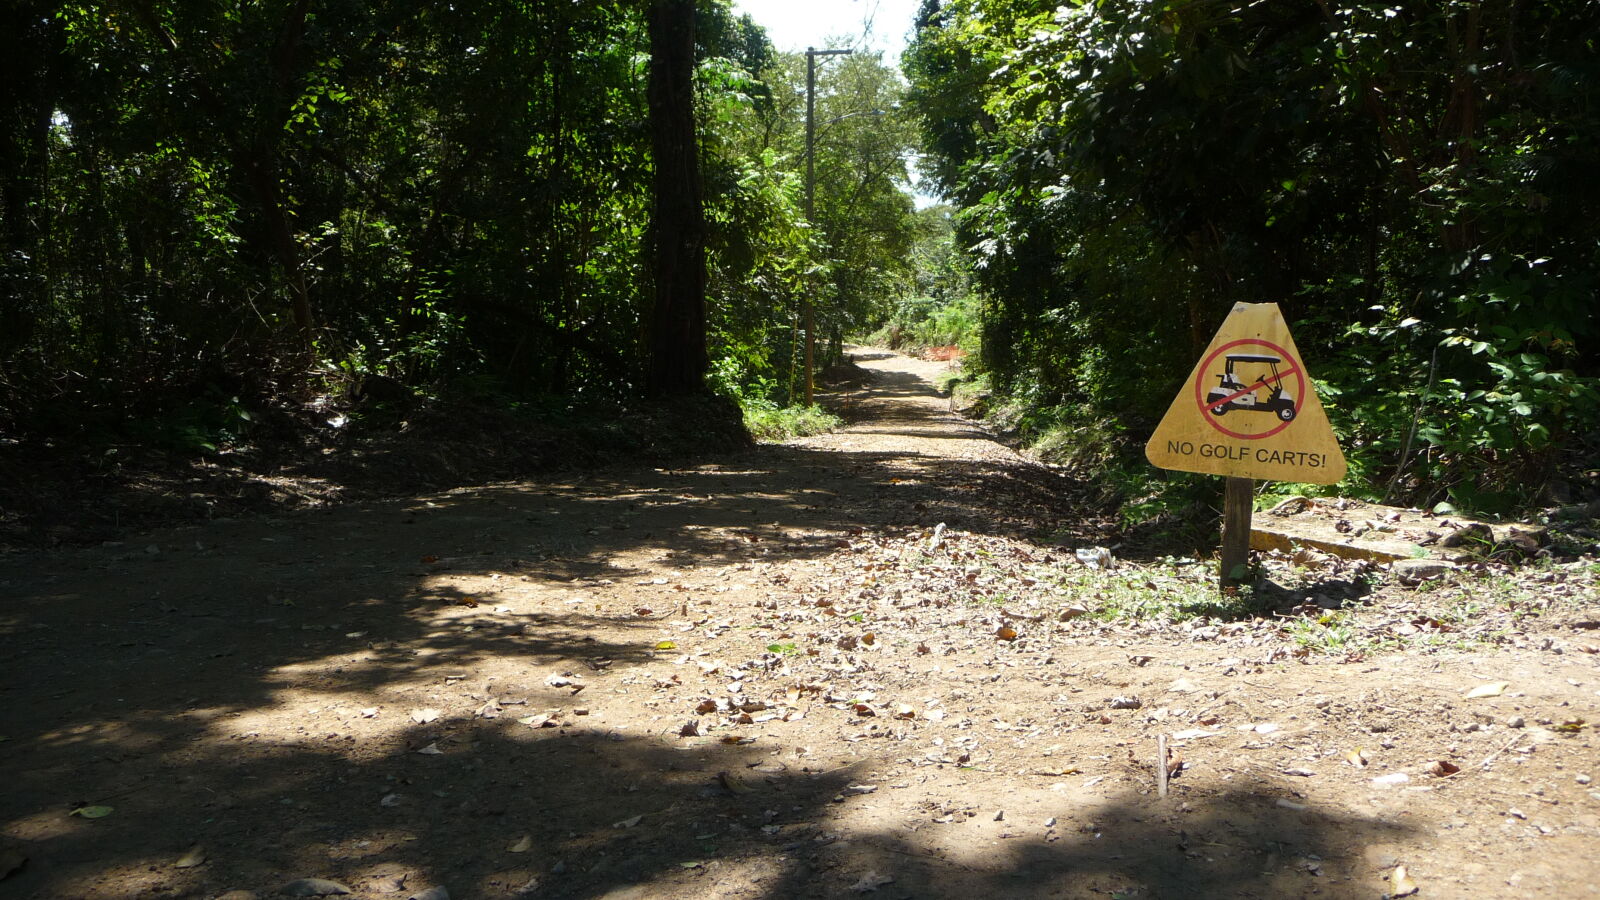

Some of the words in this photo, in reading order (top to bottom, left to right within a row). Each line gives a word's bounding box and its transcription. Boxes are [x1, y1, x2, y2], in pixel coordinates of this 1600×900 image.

[1167, 440, 1194, 455] NO
[1200, 444, 1250, 460] GOLF
[1255, 448, 1326, 468] CARTS!
